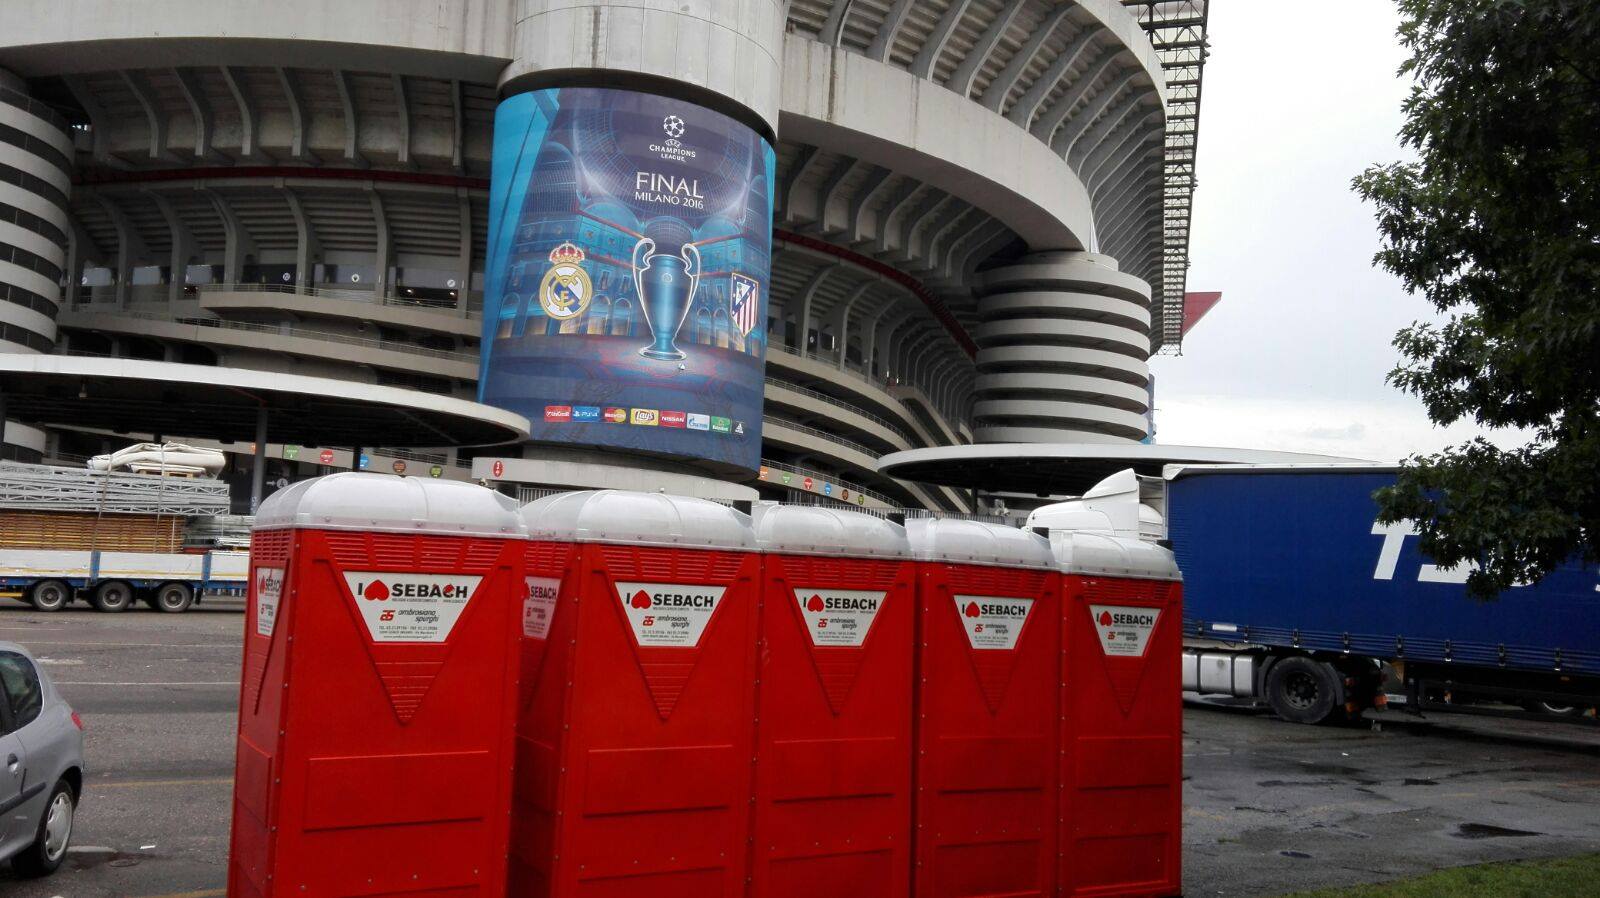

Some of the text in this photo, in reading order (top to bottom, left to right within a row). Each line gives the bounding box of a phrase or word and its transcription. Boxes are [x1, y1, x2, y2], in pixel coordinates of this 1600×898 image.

[649, 144, 696, 158] CHAMPIONS
[661, 153, 687, 162] LEAGUE
[636, 171, 704, 199] FINAL
[635, 191, 704, 209] MILANO 2016
[391, 583, 468, 598] SEBACH
[531, 586, 557, 599] SEBACH
[653, 593, 714, 607] SEBACH
[825, 597, 877, 610] SEBACH
[398, 608, 436, 617] ambrosiana
[980, 604, 1026, 616] SEBACH
[1113, 614, 1153, 625] SEBACH
